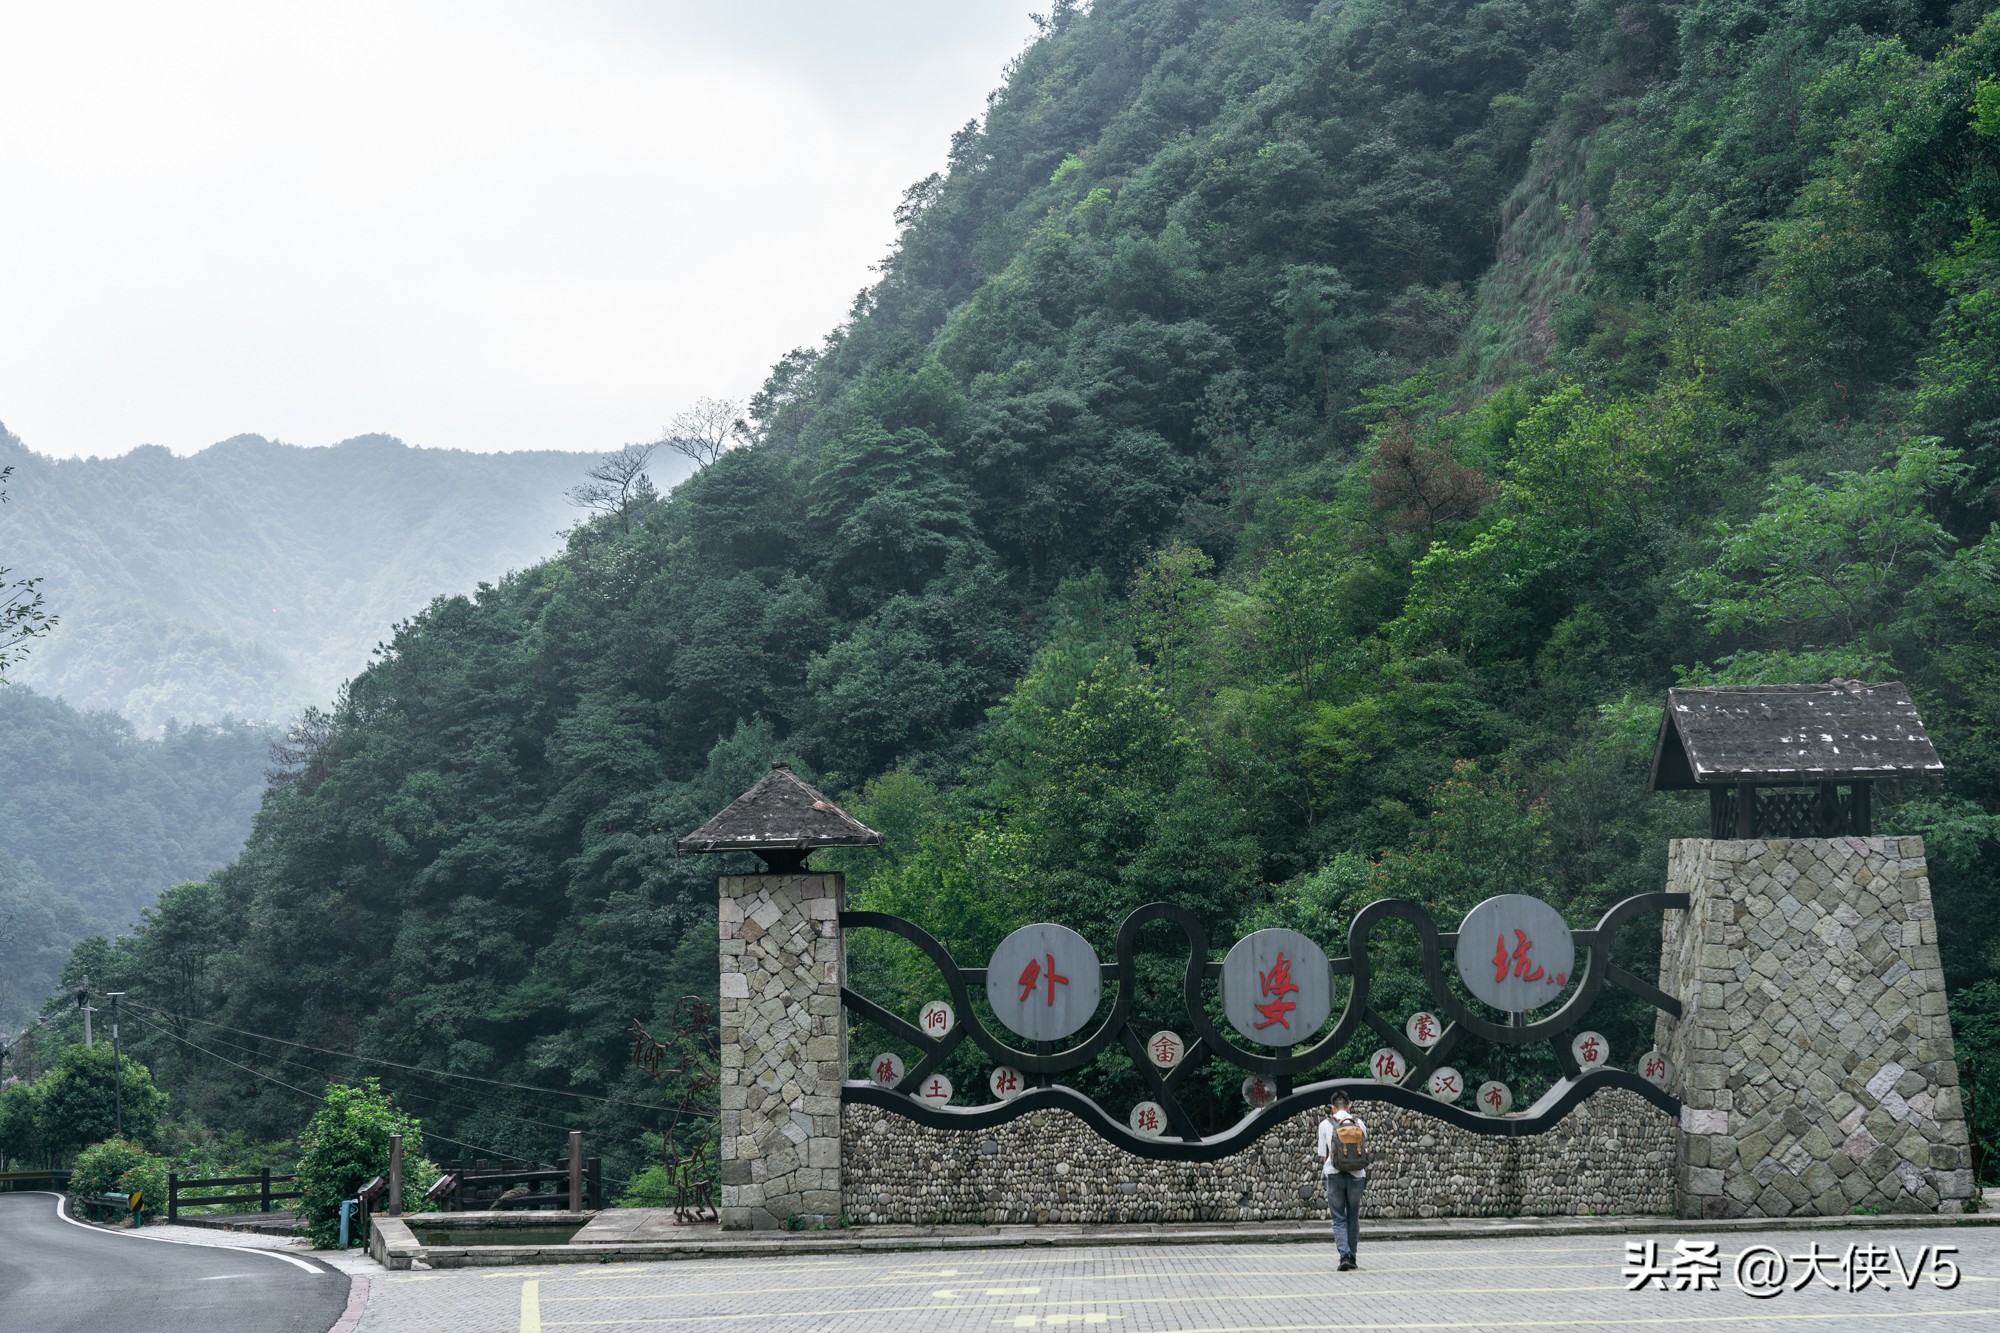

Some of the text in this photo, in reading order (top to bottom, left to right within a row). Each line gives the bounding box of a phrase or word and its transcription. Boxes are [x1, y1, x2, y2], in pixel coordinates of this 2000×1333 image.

[1018, 953, 1070, 1006] 外
[926, 1008, 948, 1030] 侗
[1416, 1014, 1436, 1042] 蒙
[1579, 1036, 1600, 1063] 苗
[876, 1057, 899, 1083] 傣
[1375, 1054, 1401, 1080] 佤
[1645, 1057, 1666, 1080] 纳
[925, 1079, 948, 1099] 土
[996, 1070, 1017, 1095] 壮
[1434, 1075, 1458, 1094] 汉
[1484, 1086, 1503, 1112] 布
[1137, 1109, 1160, 1132] 瑶
